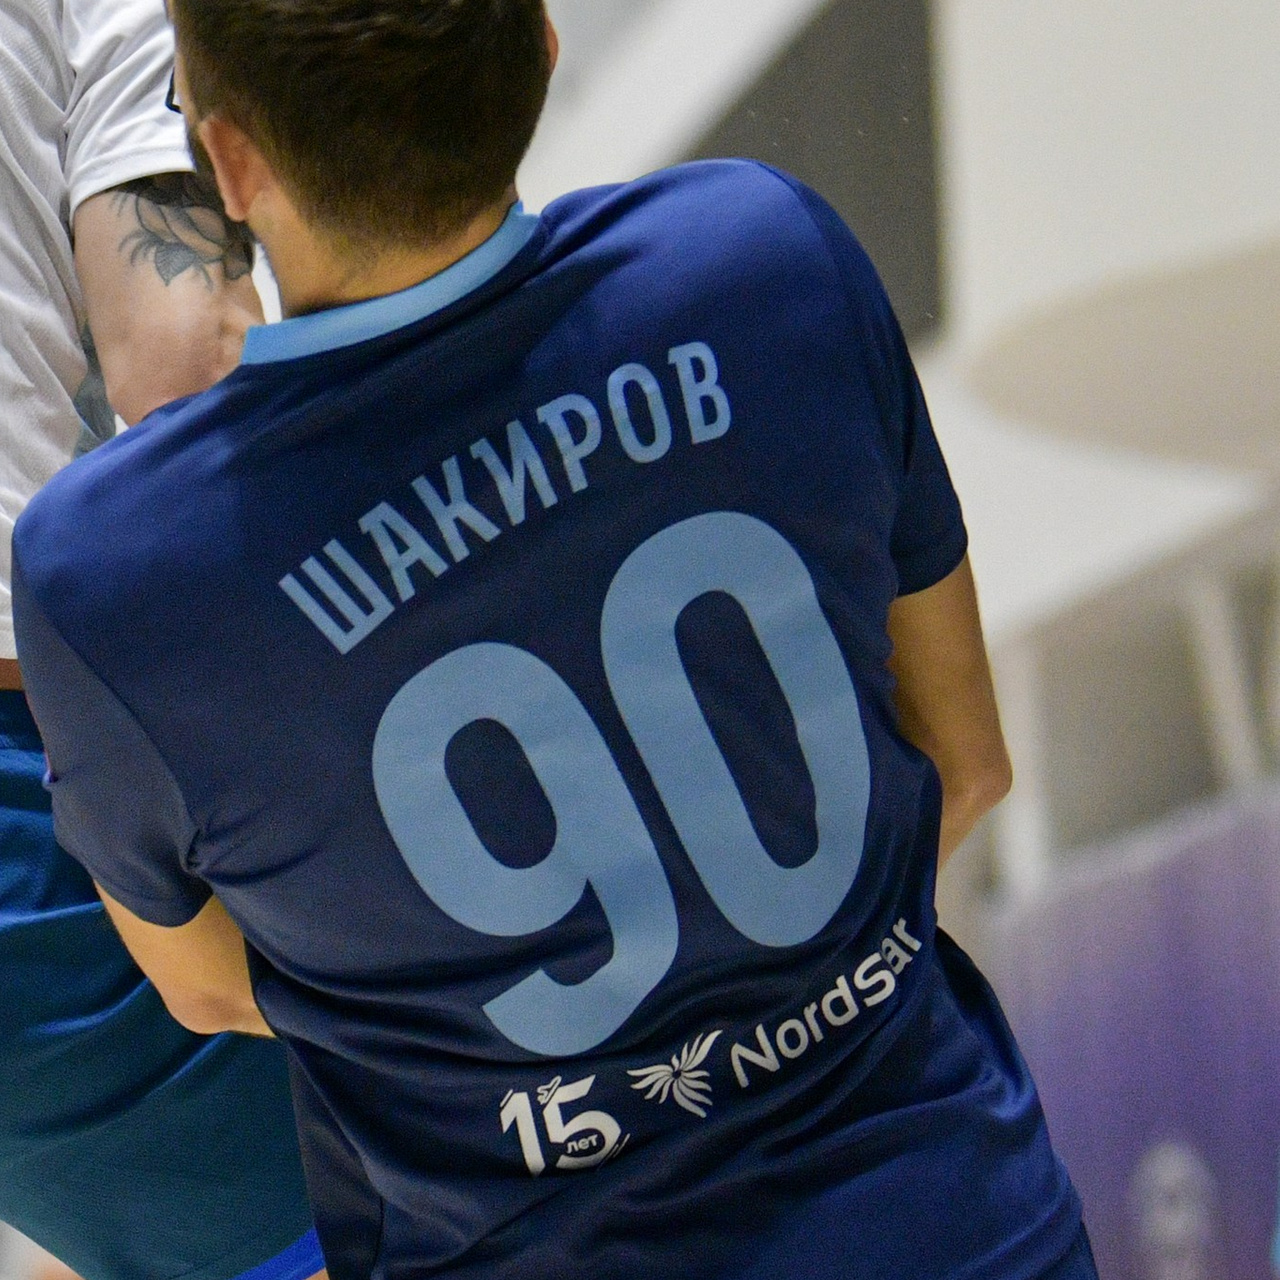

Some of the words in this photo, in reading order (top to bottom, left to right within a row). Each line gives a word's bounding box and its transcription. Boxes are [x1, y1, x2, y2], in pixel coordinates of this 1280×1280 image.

[278, 340, 733, 655] ШАКИРОВ
[372, 511, 871, 1056] 90
[500, 1074, 622, 1178] 15
[565, 1134, 599, 1154] лет
